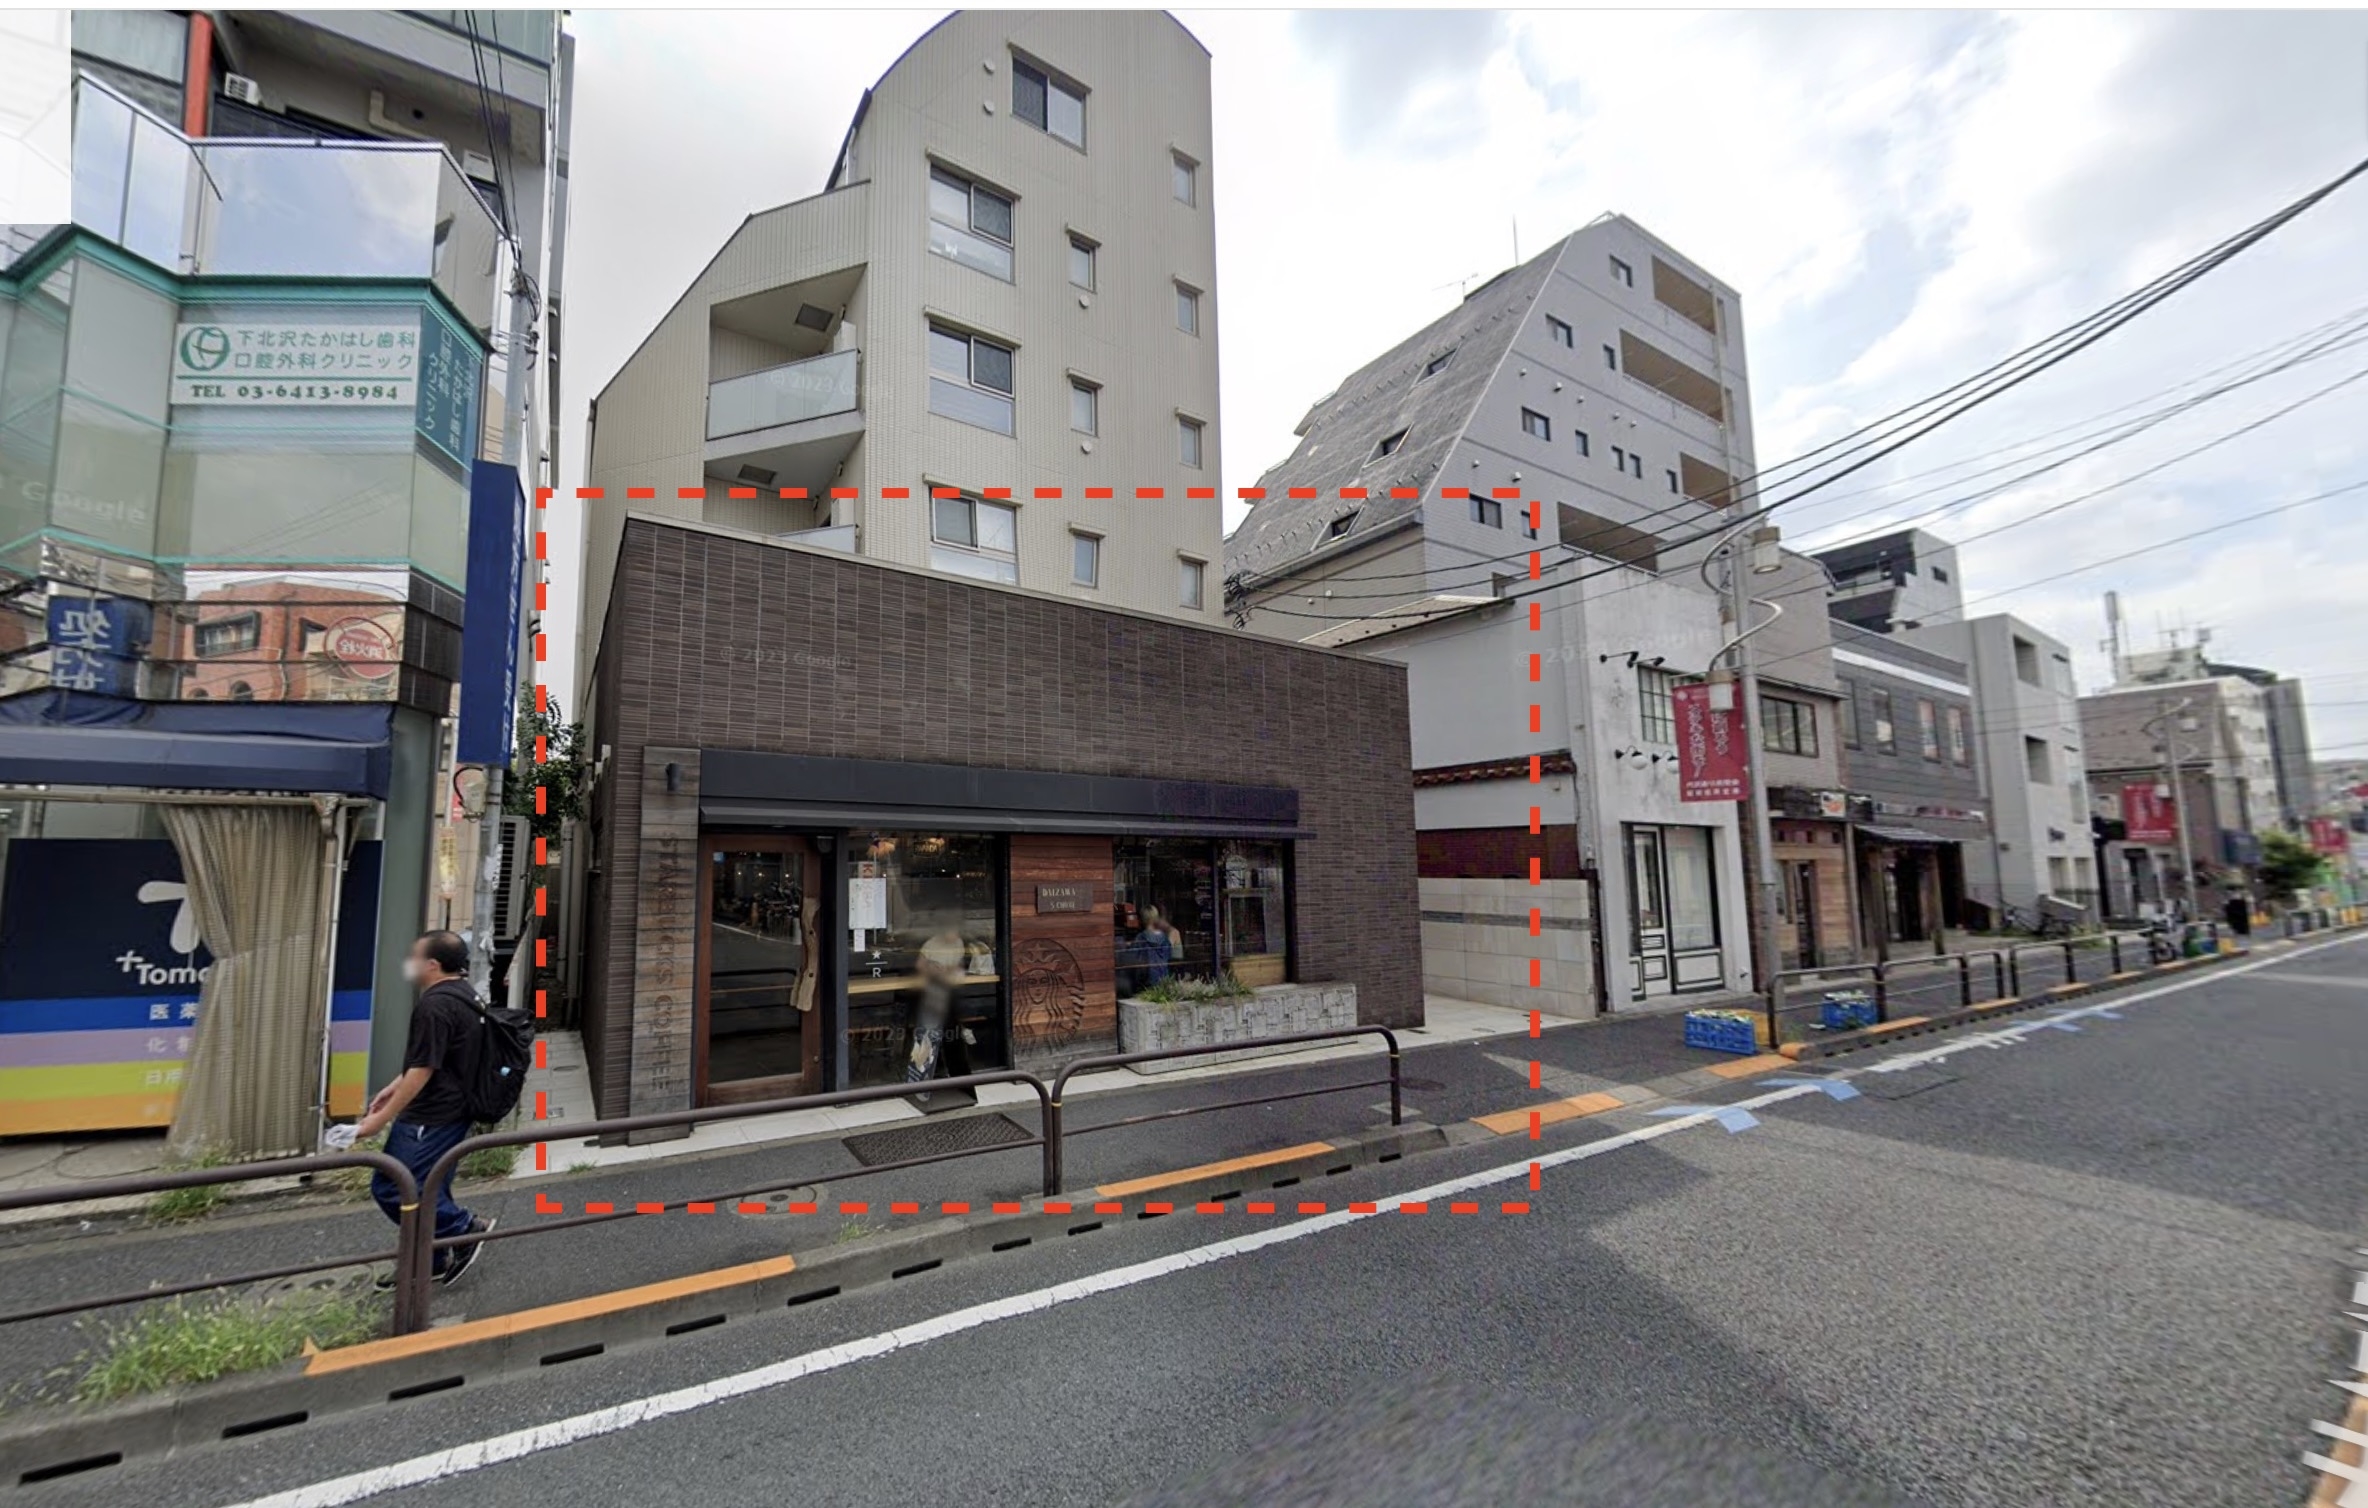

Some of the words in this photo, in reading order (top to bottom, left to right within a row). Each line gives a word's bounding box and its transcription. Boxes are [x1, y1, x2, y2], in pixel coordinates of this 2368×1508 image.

[238, 329, 416, 349] 下北沢たかはし歯科
[235, 351, 412, 370] 口腔外科クリニック
[190, 384, 226, 398] TEL
[237, 384, 398, 400] 03-6413-8984
[656, 832, 679, 986] STARBUCKS
[652, 994, 674, 1092] COFFEE
